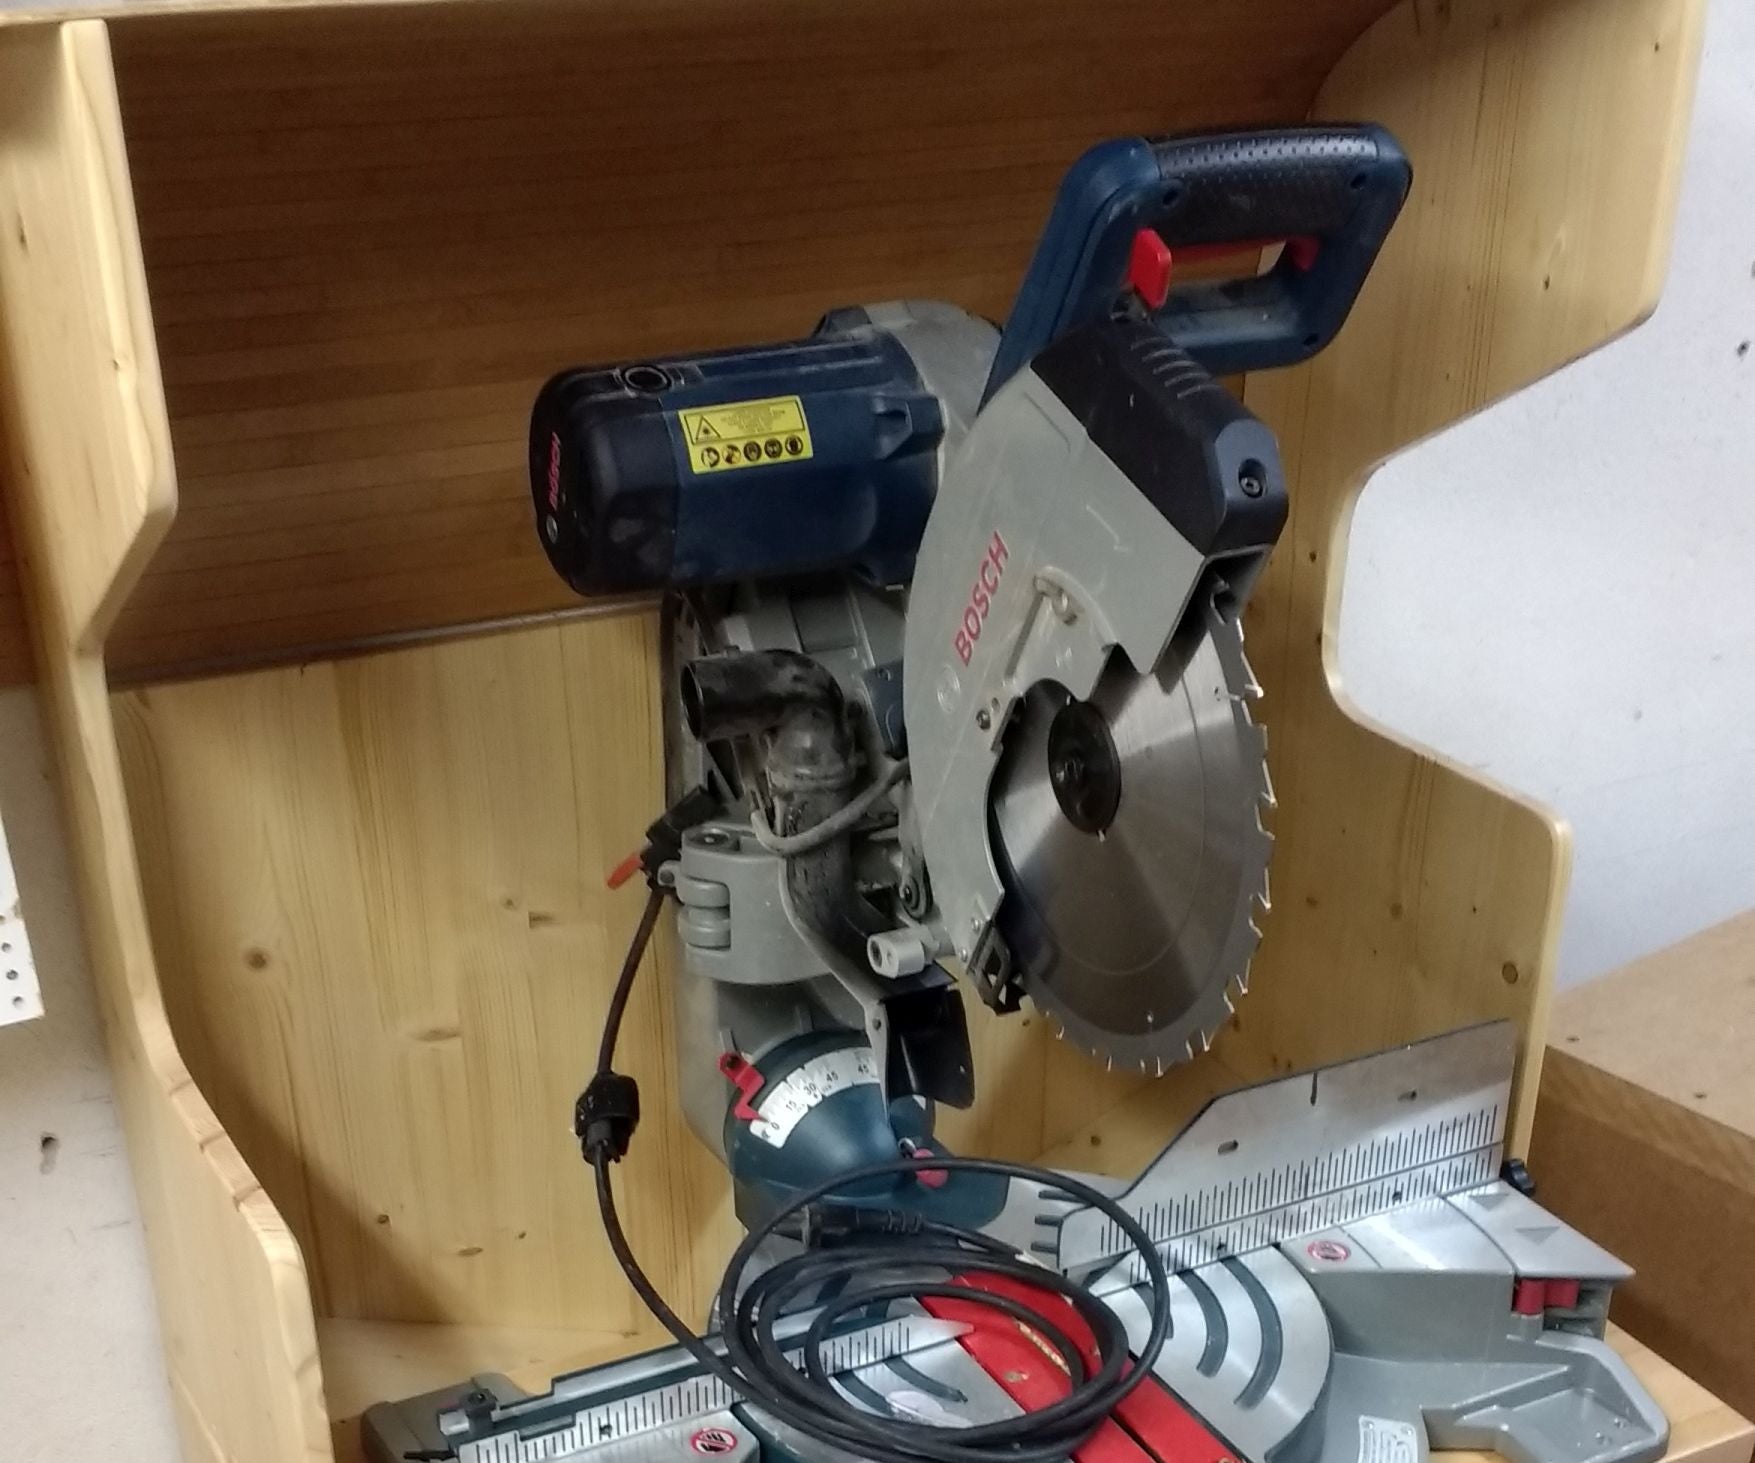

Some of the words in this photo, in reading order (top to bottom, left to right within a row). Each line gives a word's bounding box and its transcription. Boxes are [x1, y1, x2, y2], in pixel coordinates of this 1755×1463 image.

[954, 530, 1009, 668] BOSCH
[857, 1063, 870, 1075] 45
[826, 1071, 839, 1082] 45
[803, 1082, 817, 1096] 30
[785, 1099, 797, 1111] 15
